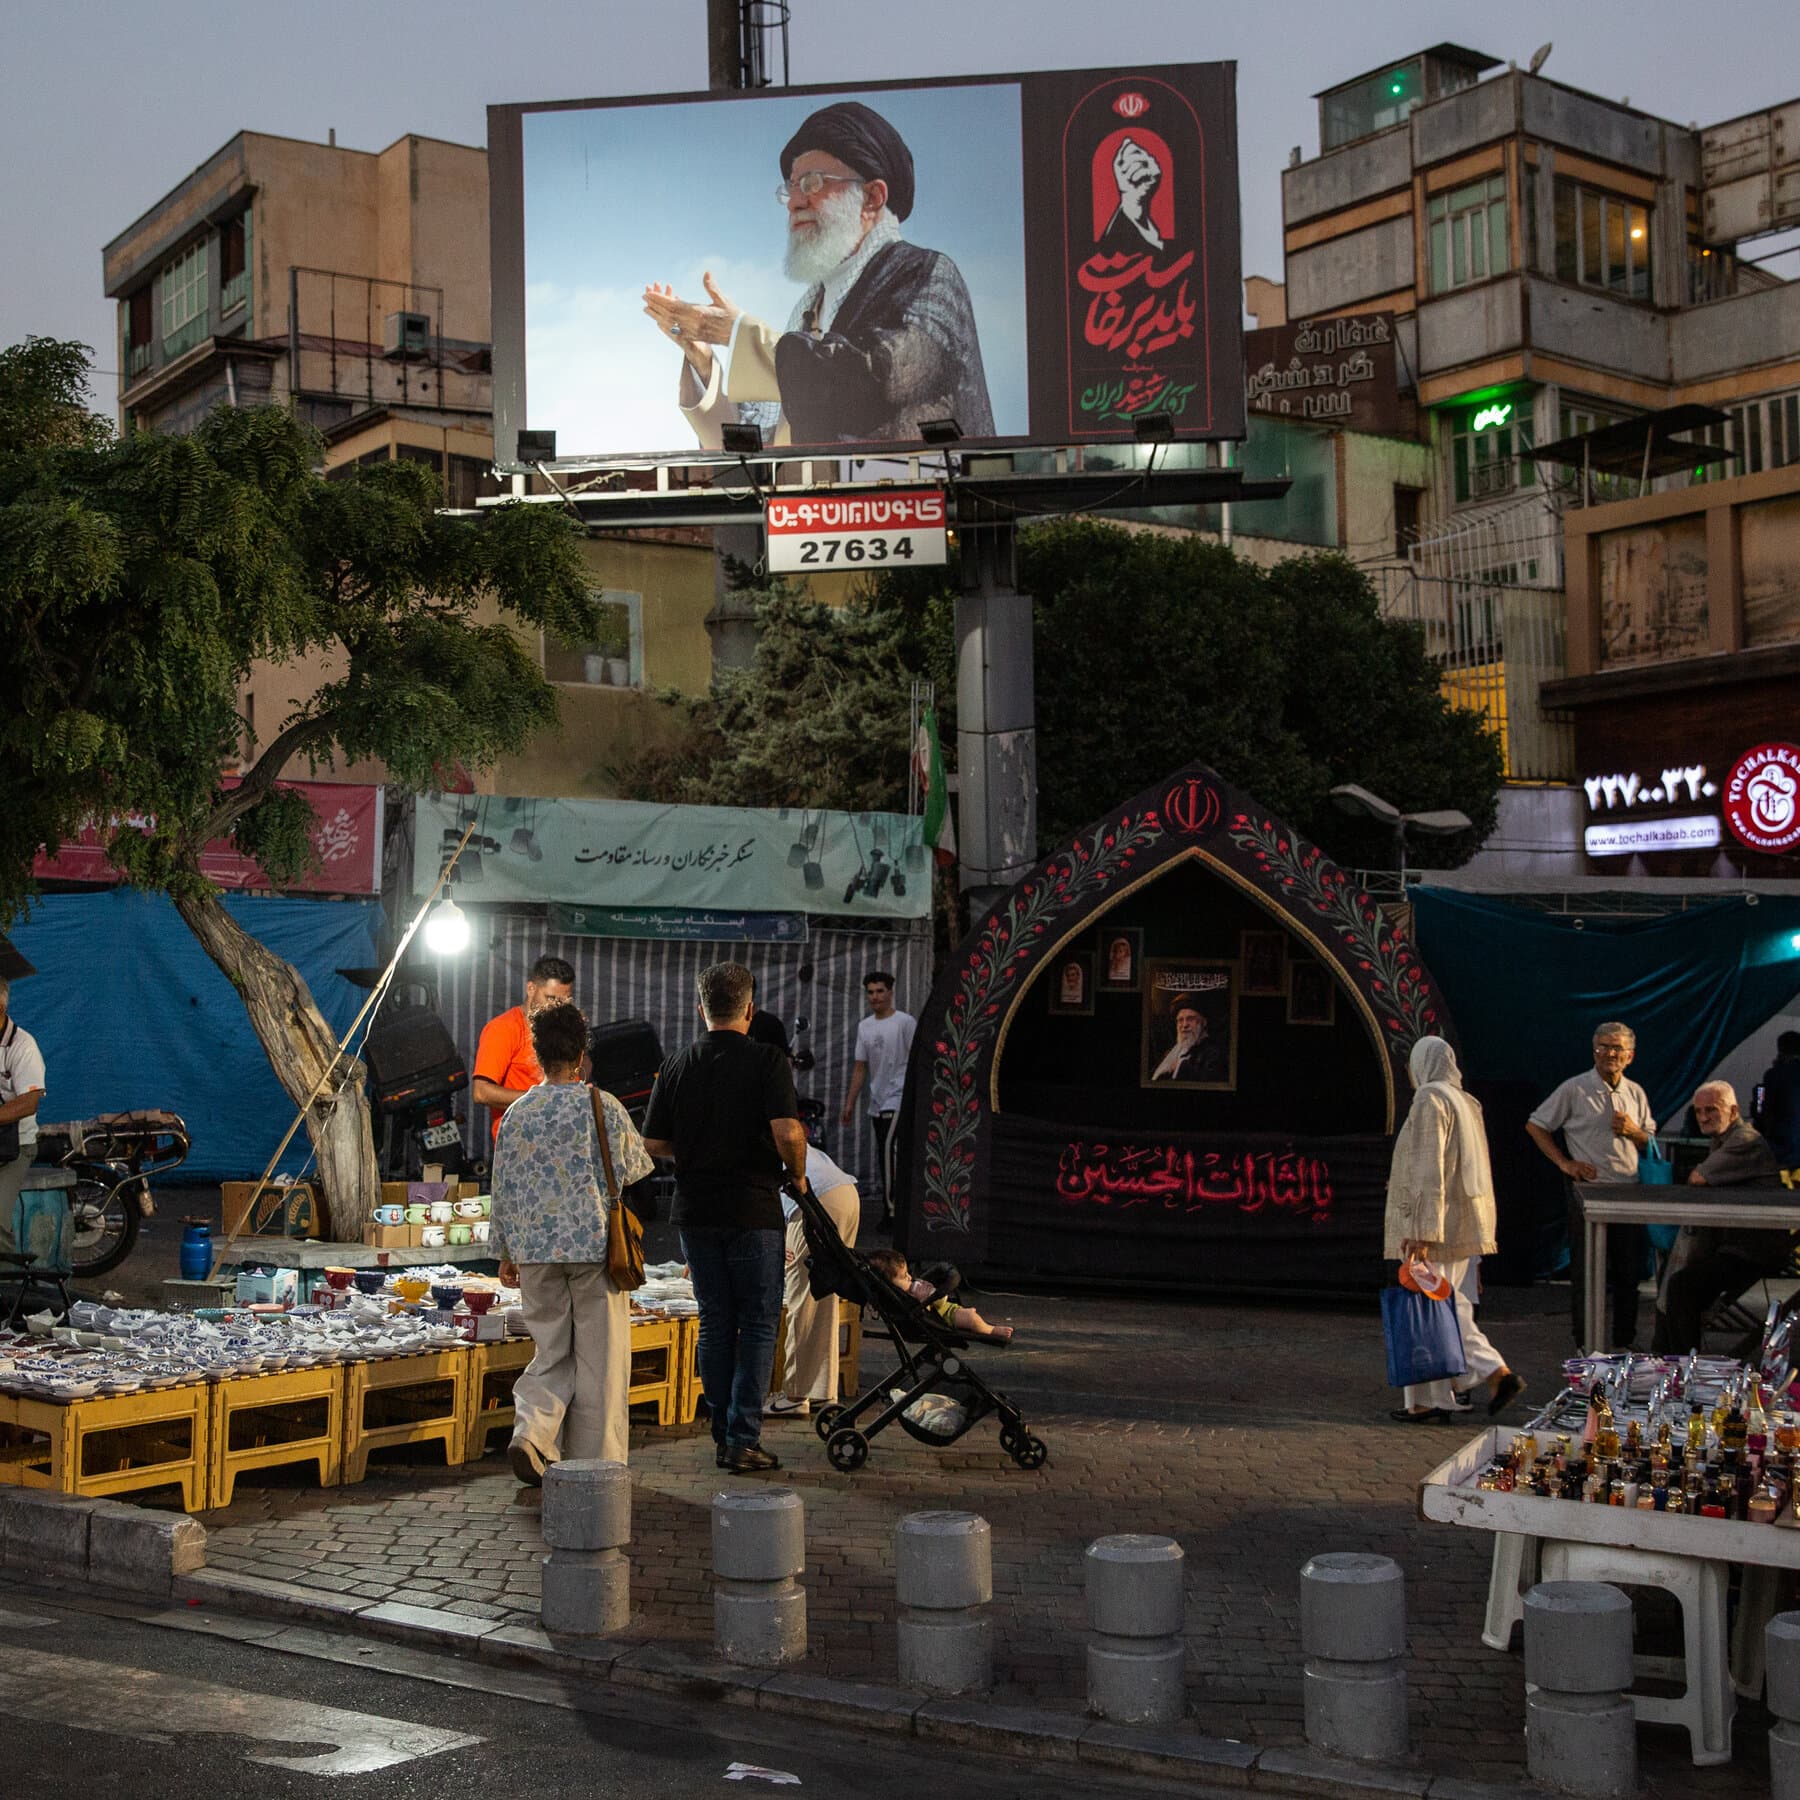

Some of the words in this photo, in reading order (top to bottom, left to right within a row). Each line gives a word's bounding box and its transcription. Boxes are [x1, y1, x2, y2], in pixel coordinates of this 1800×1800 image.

[769, 502, 820, 528] نوین
[821, 500, 871, 526] ایران
[872, 498, 942, 523] کانون
[799, 536, 915, 564] 27634
[1588, 826, 1716, 847] www.tochalkabab.com
[574, 844, 633, 866] مقاومت
[632, 846, 662, 867] رسانه
[672, 843, 730, 872] خبرنگاران
[728, 838, 756, 868] سنگر
